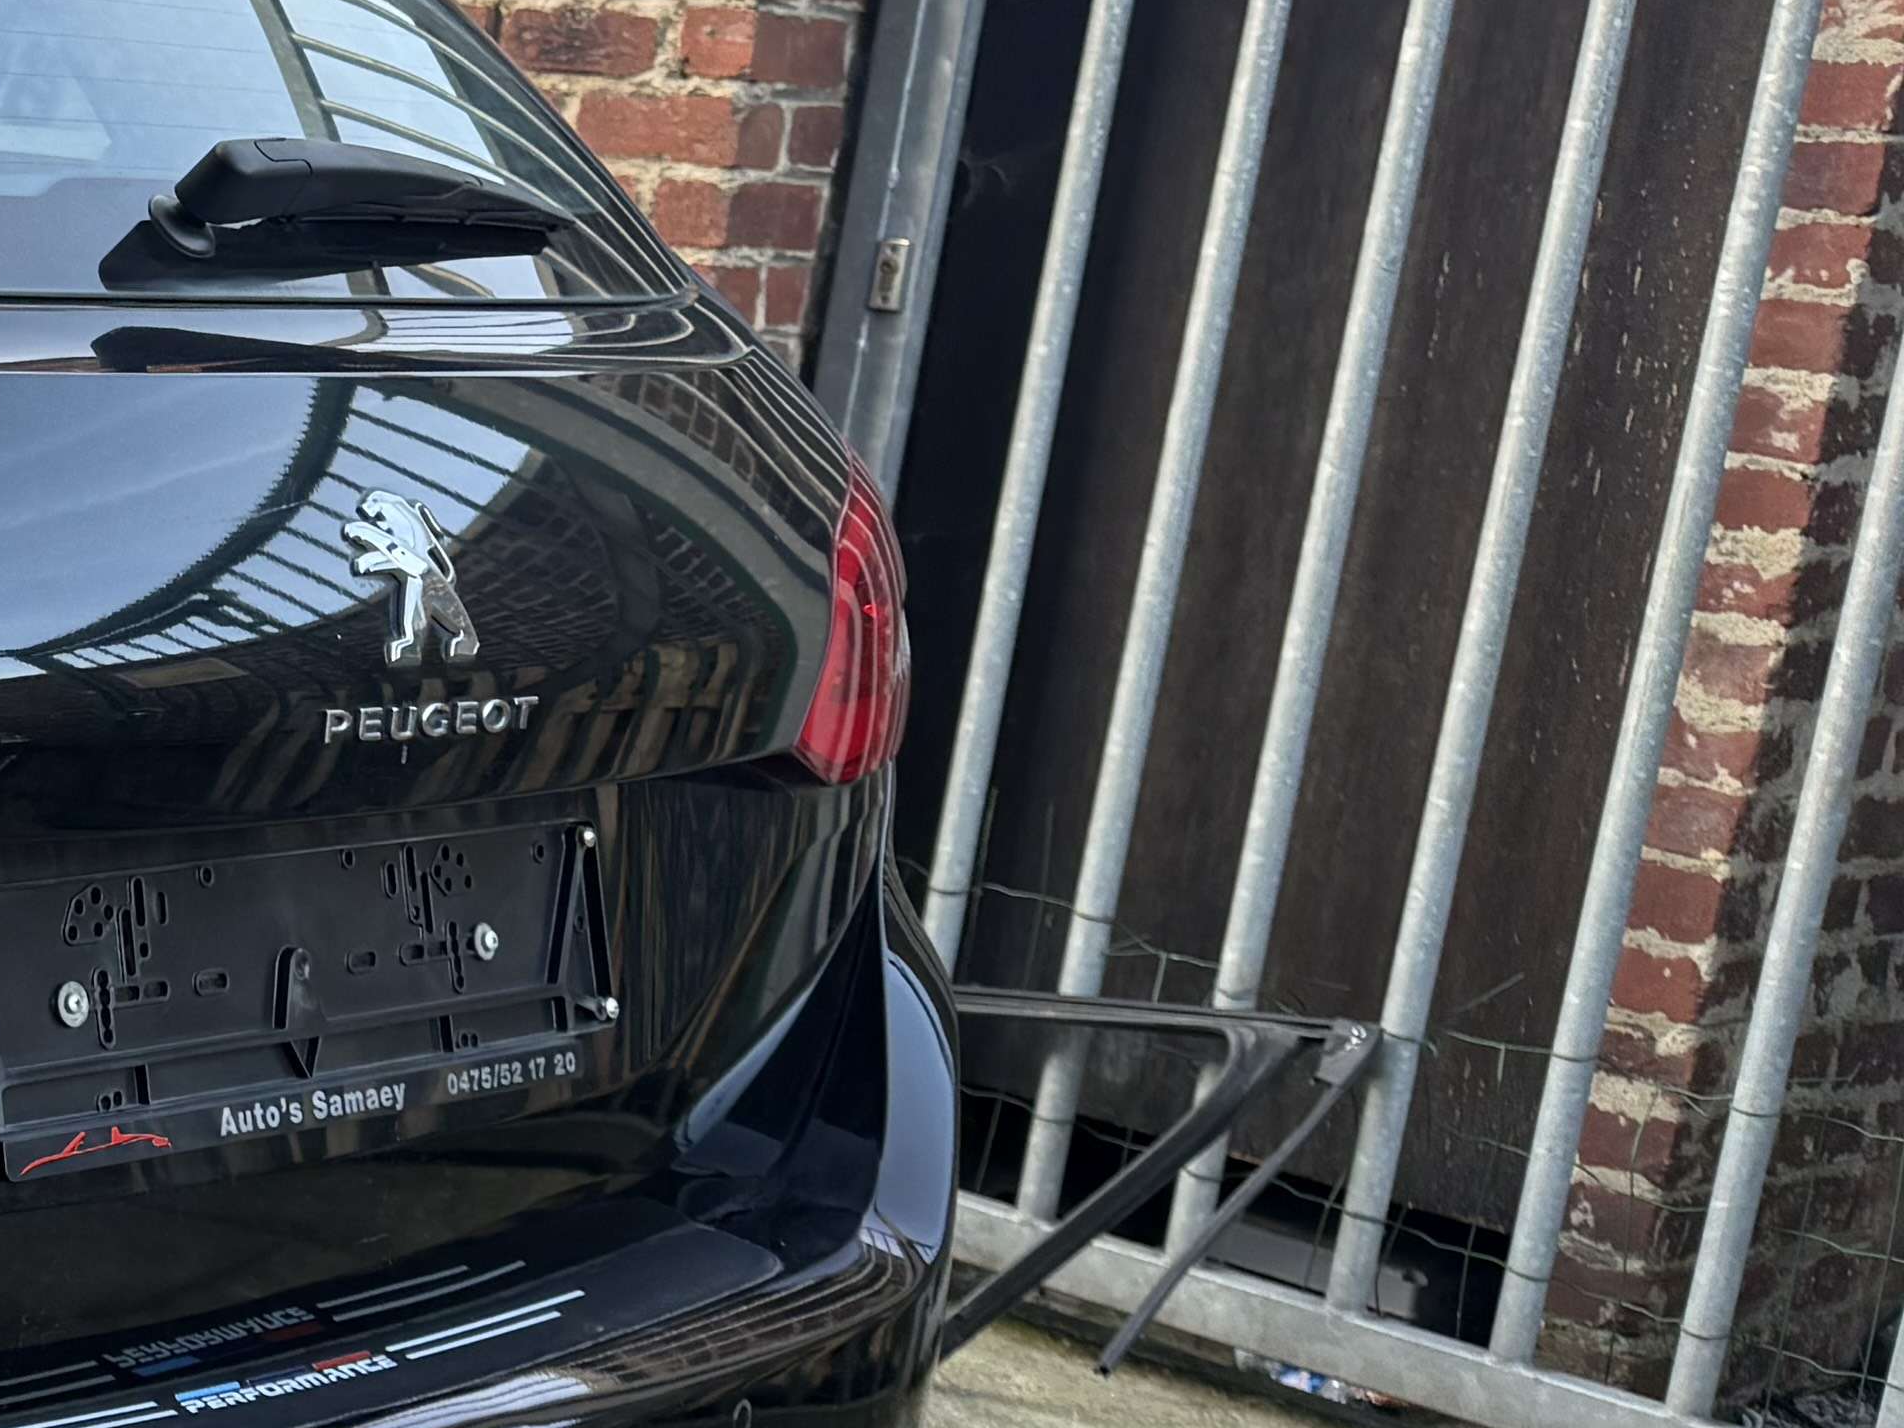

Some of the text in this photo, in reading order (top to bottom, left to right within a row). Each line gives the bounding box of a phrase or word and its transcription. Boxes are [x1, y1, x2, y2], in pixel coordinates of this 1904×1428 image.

[324, 696, 540, 744] PEUGEOT
[220, 1051, 577, 1137] Auto's Samaey 0475/52 17 20
[180, 1353, 398, 1414] PERFORMANCE
